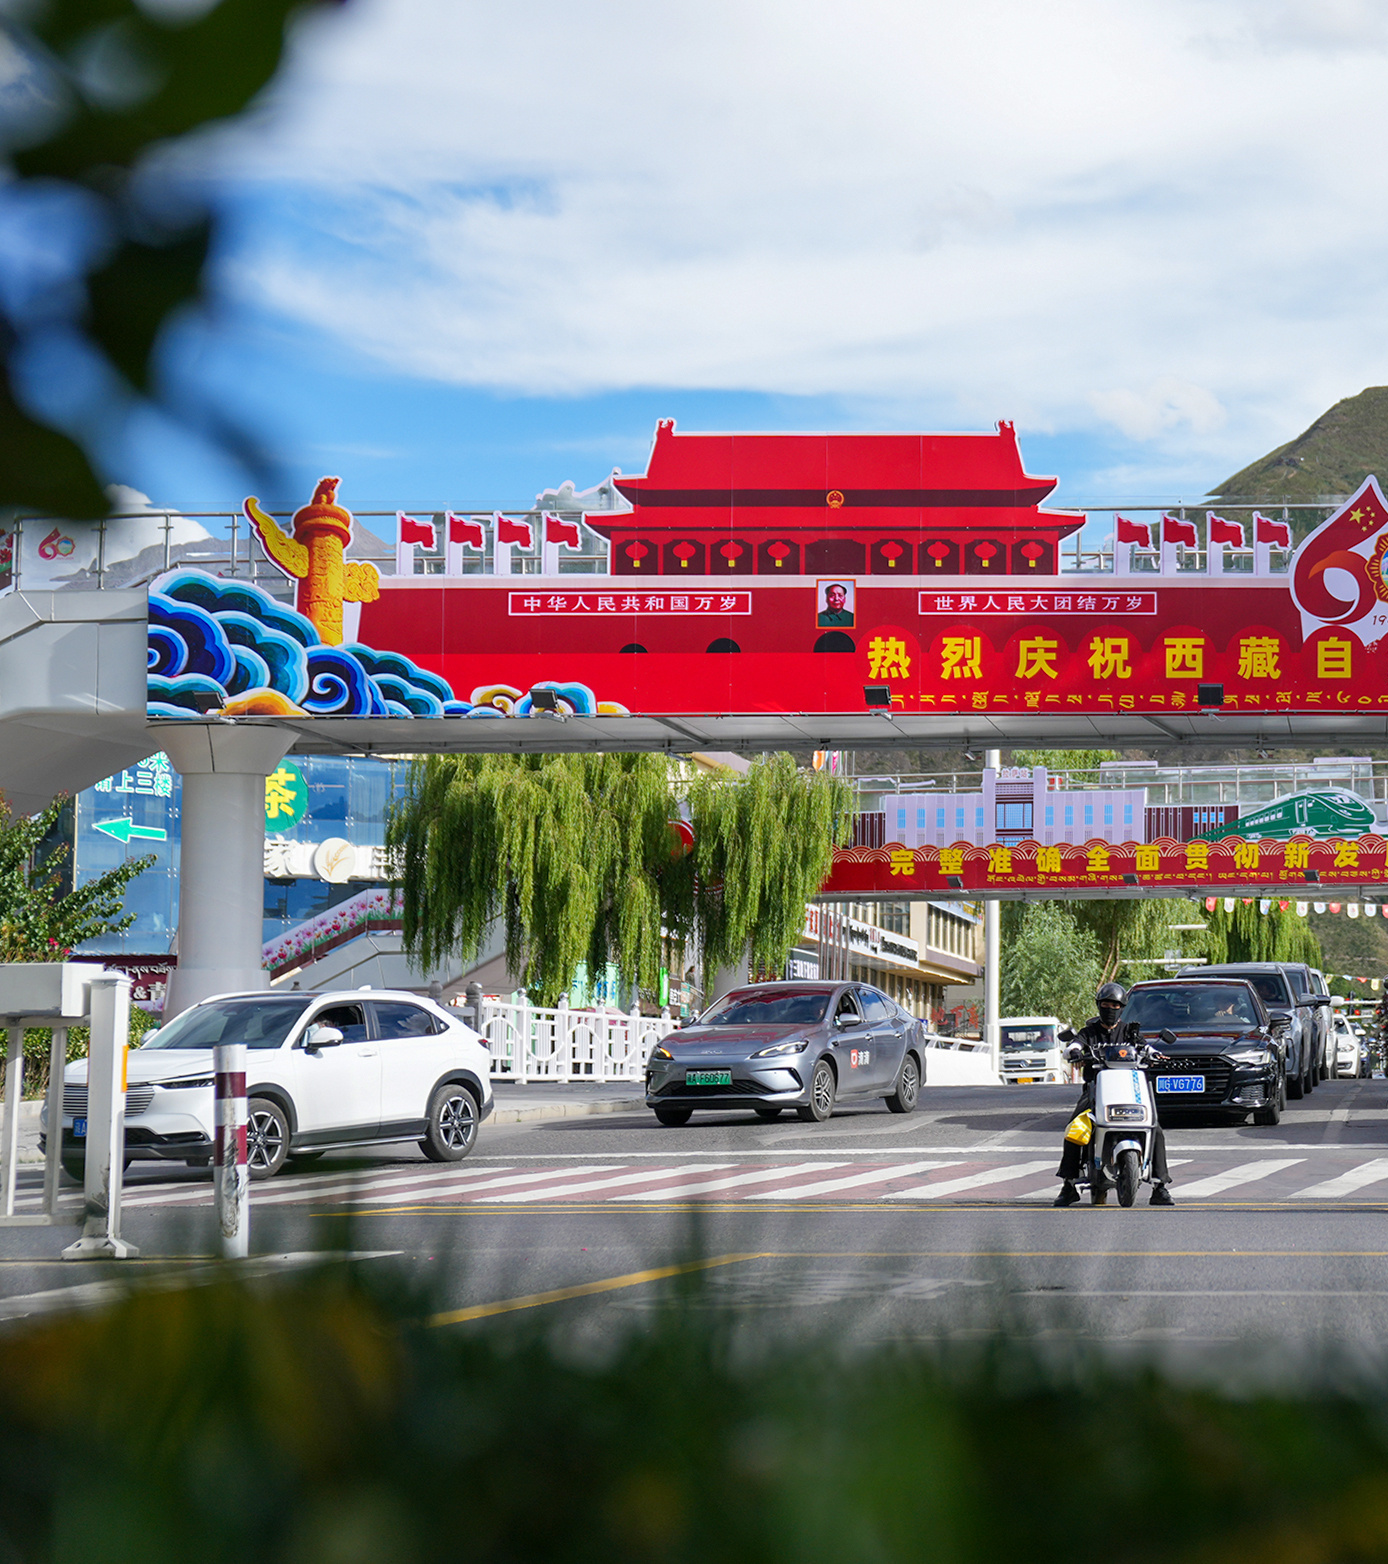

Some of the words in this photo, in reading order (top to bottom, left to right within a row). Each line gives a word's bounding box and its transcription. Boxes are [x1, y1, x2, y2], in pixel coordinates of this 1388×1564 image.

[523, 595, 737, 612] 中华人民共和国万岁
[934, 595, 1143, 611] 世界人民大团结万岁
